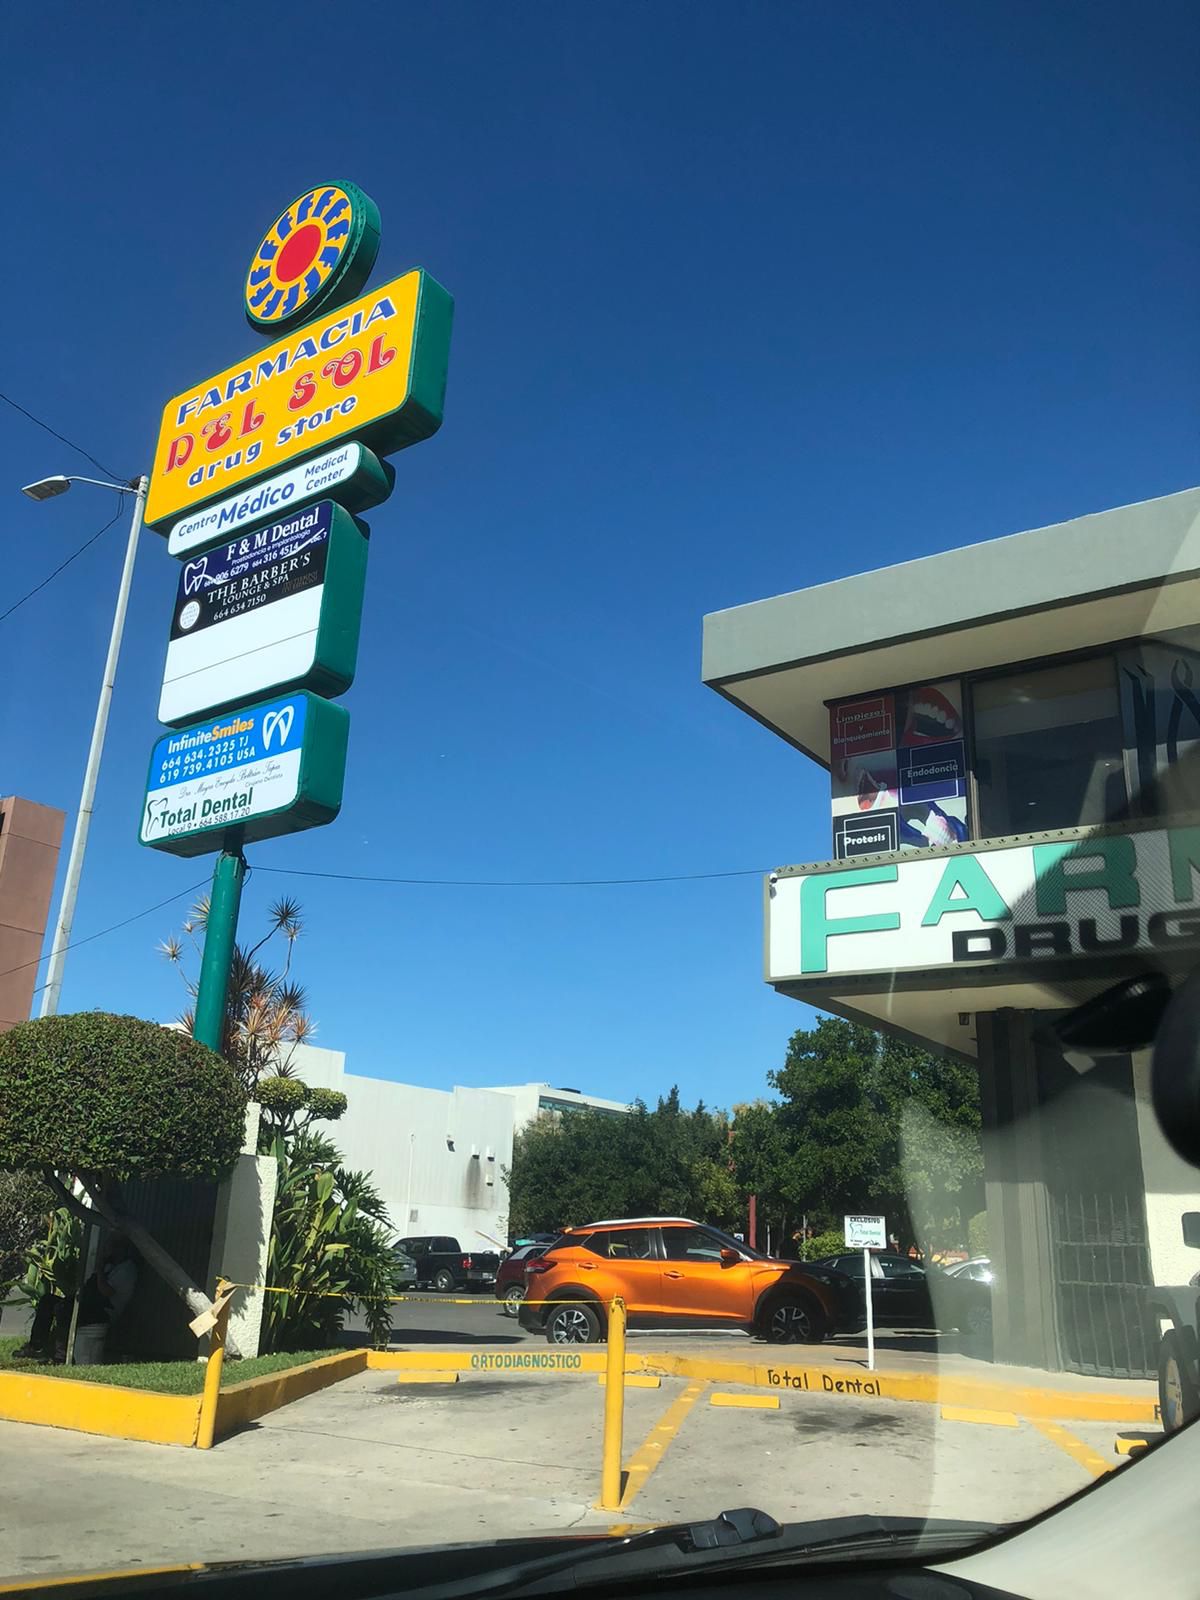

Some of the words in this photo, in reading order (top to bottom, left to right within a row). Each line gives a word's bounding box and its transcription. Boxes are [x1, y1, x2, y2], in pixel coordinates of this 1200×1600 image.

[176, 297, 397, 427] FARMACIA
[163, 398, 266, 476] DEL
[287, 333, 397, 412] SOL
[187, 441, 263, 487] drug
[276, 396, 357, 446] store
[304, 450, 348, 478] Medical
[305, 467, 344, 491] Center
[178, 513, 217, 537] Centro
[217, 482, 295, 529] Médico
[226, 543, 237, 561] F
[238, 539, 251, 556] &
[253, 529, 269, 550] M
[270, 507, 319, 543] Dental
[230, 562, 250, 577] 6279
[263, 551, 278, 564] 316
[279, 542, 299, 557] 4514
[207, 581, 237, 604] THE
[241, 552, 311, 591] BARBER'S
[222, 585, 262, 606] LOUNGE
[263, 581, 270, 590] &
[271, 573, 289, 587] SPA
[213, 607, 229, 621] 664
[230, 602, 246, 614] 634
[247, 594, 266, 608] 7150
[161, 755, 181, 771] 664
[184, 739, 235, 765] 634.2325
[239, 735, 249, 747] TJ
[168, 717, 254, 754] InfiniteSmiles
[159, 768, 179, 784] 619
[182, 755, 233, 781] 739.4105
[236, 746, 255, 761] USA
[907, 762, 958, 778] Endodoncia
[160, 802, 197, 828] Total
[201, 787, 253, 817] Dental
[168, 824, 186, 836] Local
[187, 822, 192, 831] 9
[844, 833, 886, 846] Protesis
[471, 1354, 581, 1368] ORTODIAGNOSTICO
[767, 1369, 809, 1390] Total
[822, 1374, 880, 1396] Dental
